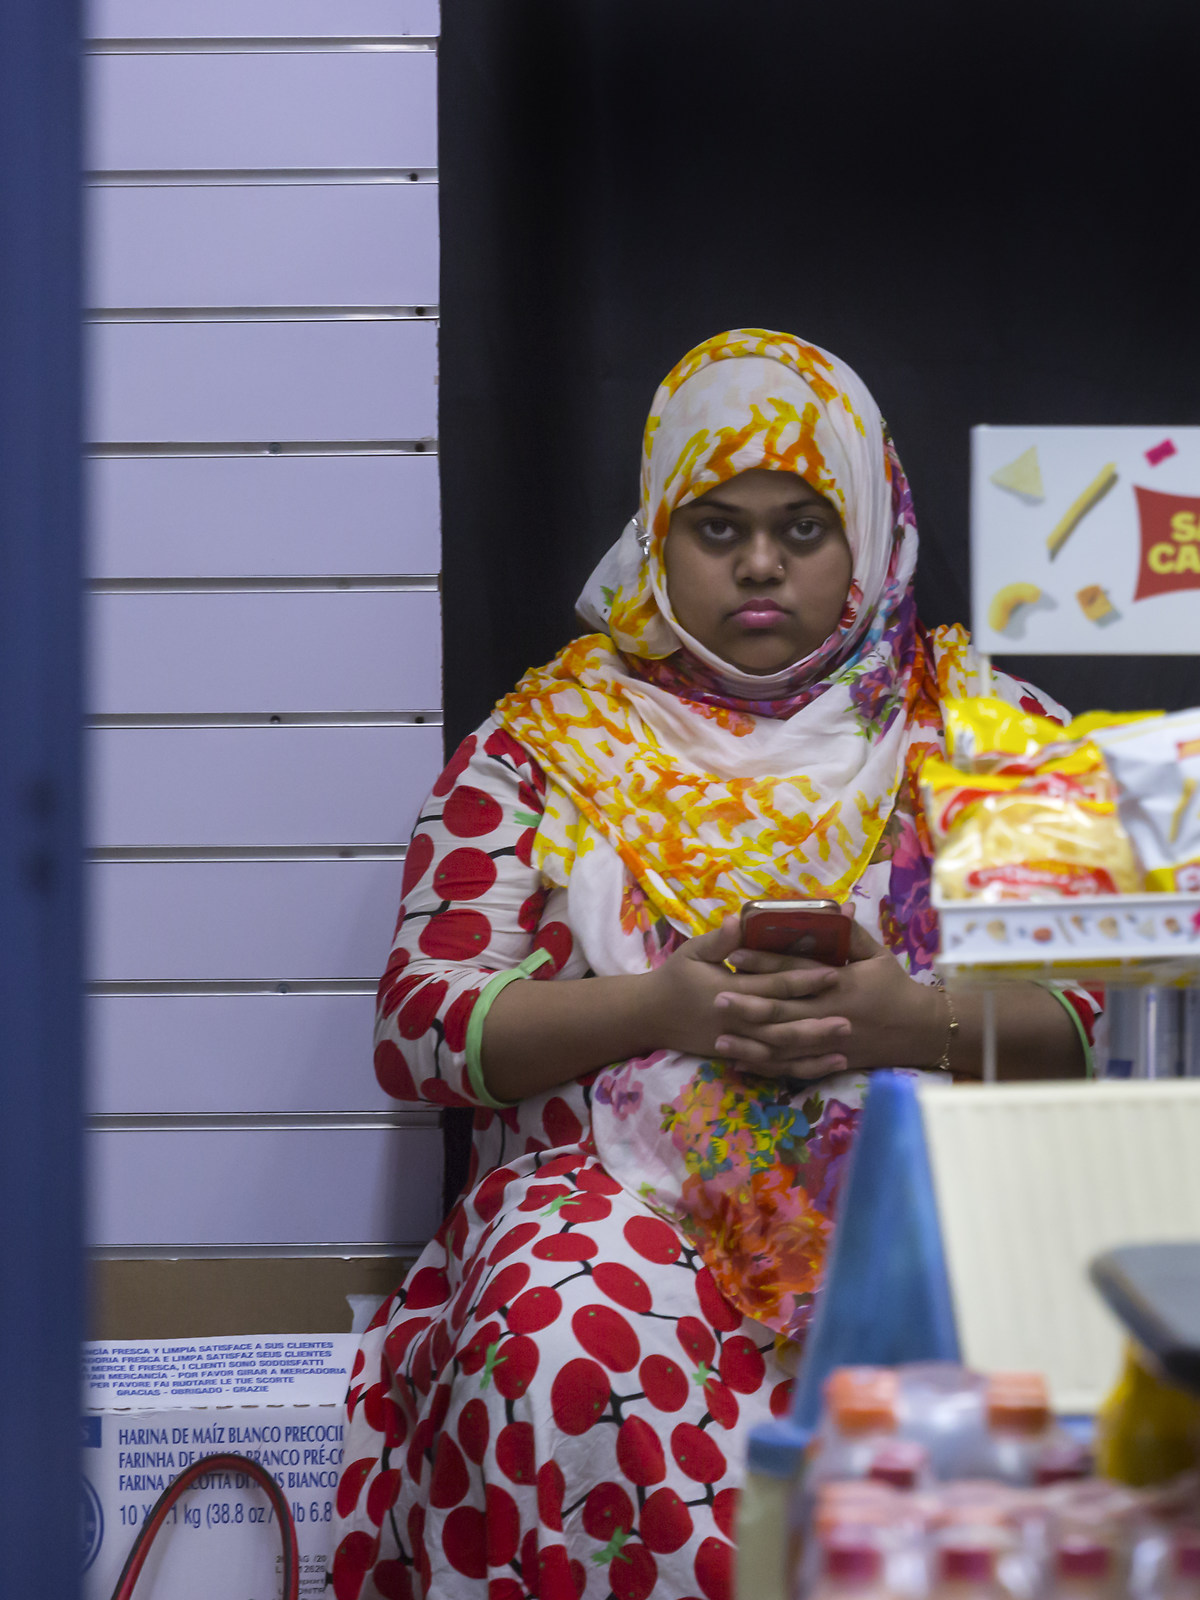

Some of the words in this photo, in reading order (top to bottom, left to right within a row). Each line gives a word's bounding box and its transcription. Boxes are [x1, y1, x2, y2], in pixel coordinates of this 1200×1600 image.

[162, 1346, 196, 1354] LIMPIA
[199, 1343, 252, 1352] SATISFACE
[287, 1341, 334, 1349] CLIENTES
[172, 1354, 204, 1362] LIMPA
[206, 1351, 253, 1360] SATISFAZ
[284, 1350, 332, 1358] CLIENTES
[188, 1361, 226, 1370] CLIENTI
[228, 1360, 256, 1368] SONO
[259, 1359, 324, 1367] SODDISFATTI
[108, 1372, 168, 1380] MERCANCÍA
[201, 1370, 234, 1378] FAVOR
[237, 1368, 267, 1376] GIRAR
[280, 1367, 347, 1375] MERCADORIA
[172, 1379, 218, 1387] RUOTARE
[256, 1376, 295, 1384] SCORTE
[171, 1387, 222, 1395] OBRIGADO
[232, 1385, 269, 1393] GRAZIE
[119, 1428, 168, 1445] HARINA
[172, 1428, 189, 1444] DE
[192, 1422, 225, 1443] MAÍZ
[228, 1426, 281, 1443] BLANCO
[119, 1451, 174, 1468] FARINHA
[179, 1451, 195, 1467] DE
[119, 1474, 164, 1491] FARINA
[235, 1473, 249, 1489] DI
[288, 1471, 338, 1488] BIANCO
[119, 1504, 137, 1525] 10
[184, 1504, 201, 1528] kg
[206, 1503, 243, 1529] (38.8
[248, 1507, 265, 1523] oz
[309, 1501, 332, 1523] 6.8
